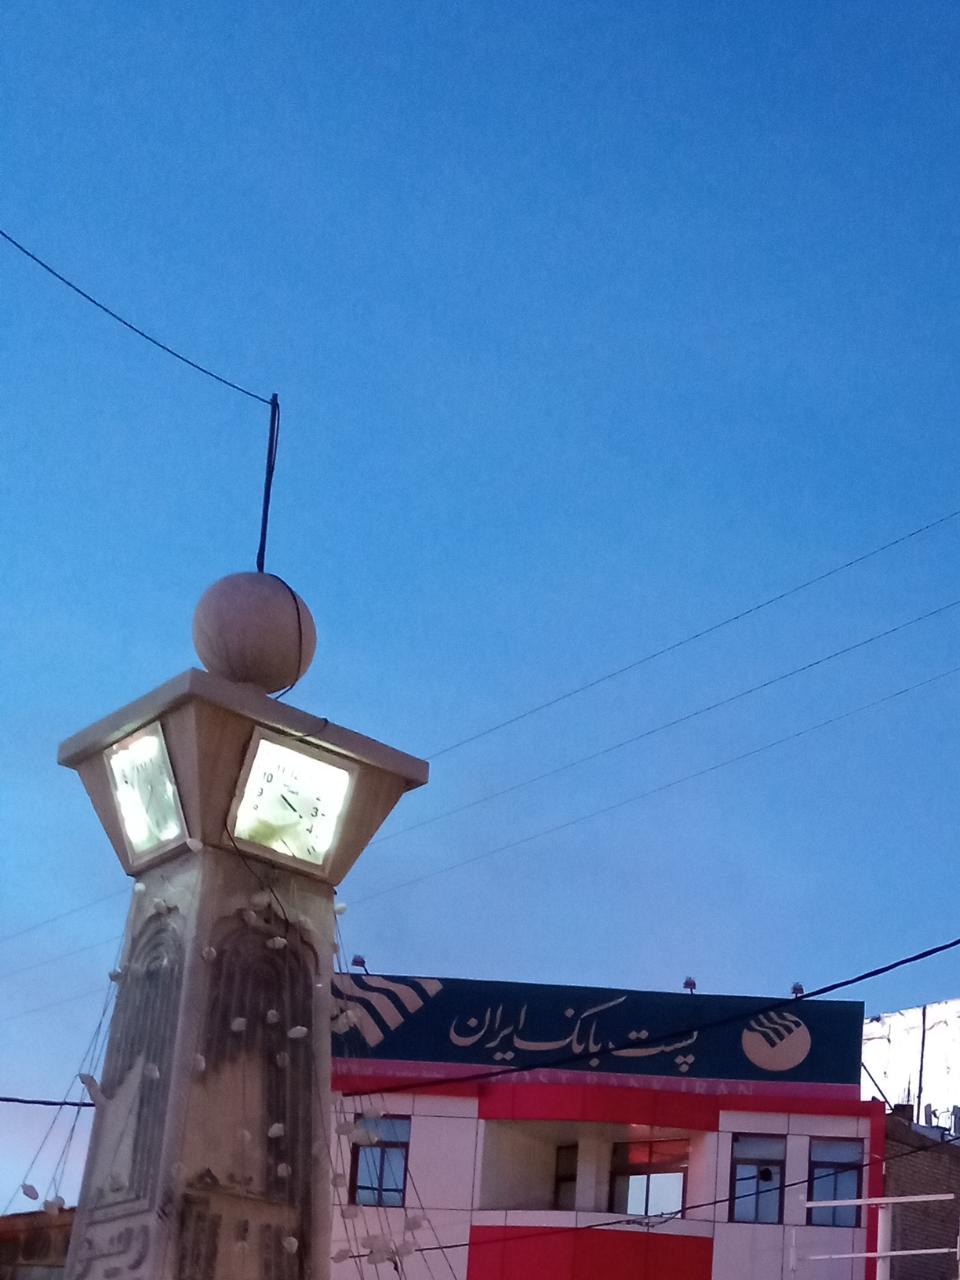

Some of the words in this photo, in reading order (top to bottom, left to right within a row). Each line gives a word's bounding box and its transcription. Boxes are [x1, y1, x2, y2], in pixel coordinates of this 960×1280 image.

[263, 771, 274, 783] 10
[310, 806, 319, 818] 3
[450, 1003, 528, 1061] ایران
[513, 995, 628, 1067] بانک
[608, 1029, 699, 1073] پست
